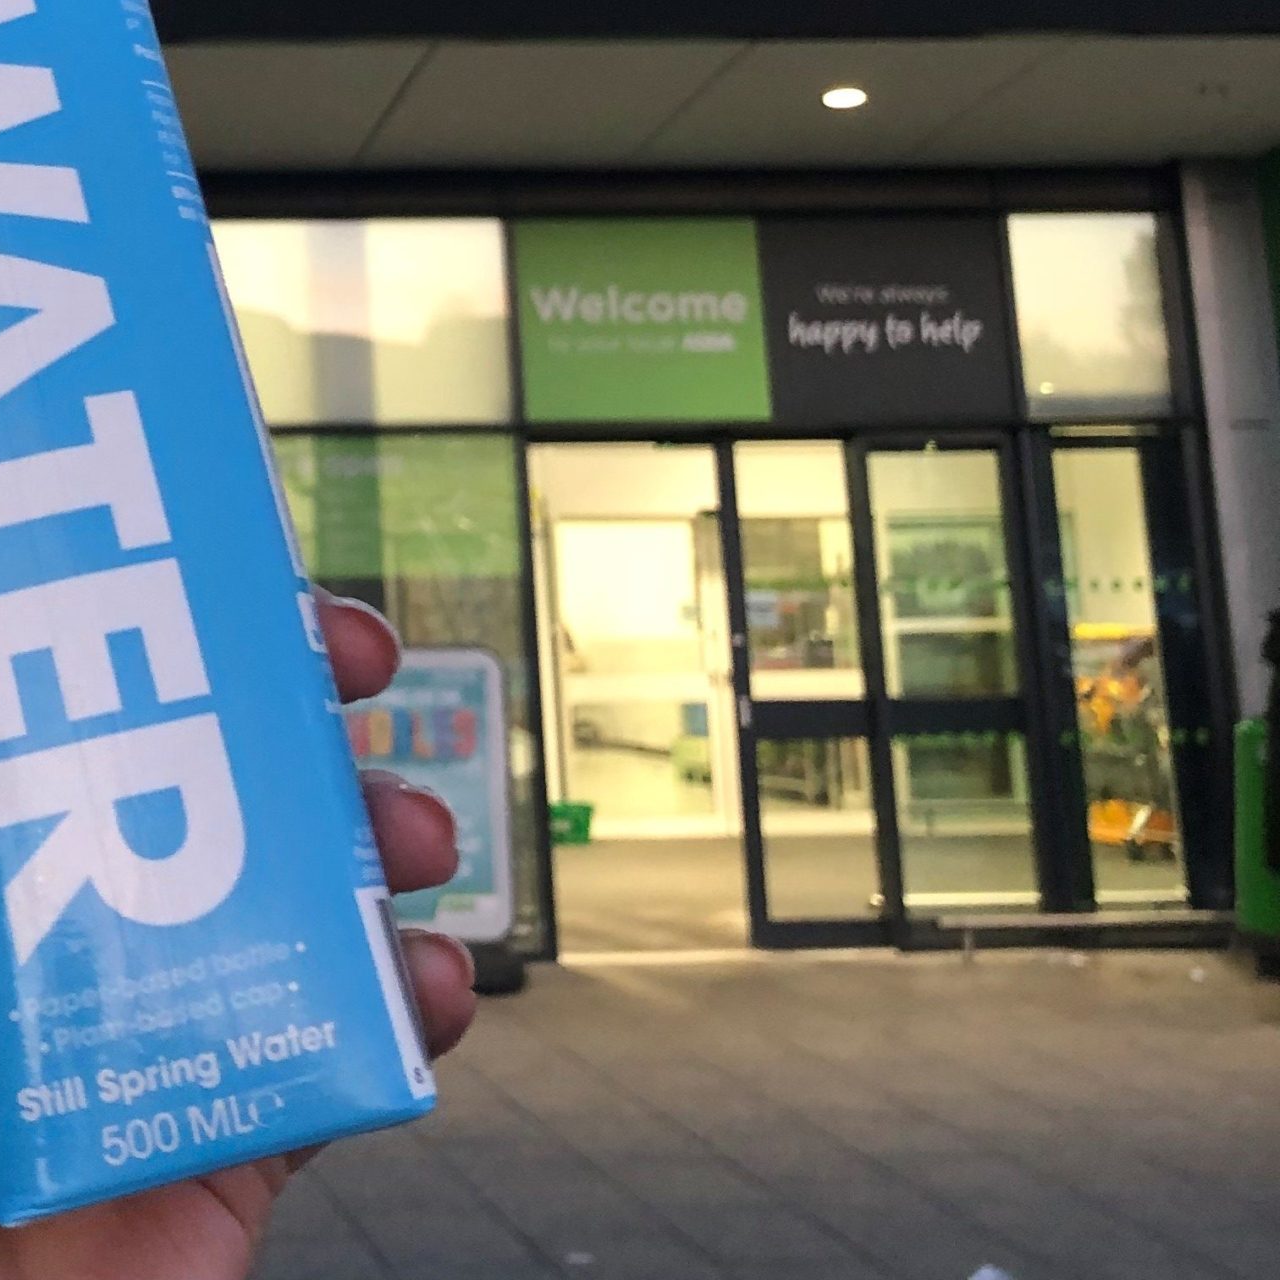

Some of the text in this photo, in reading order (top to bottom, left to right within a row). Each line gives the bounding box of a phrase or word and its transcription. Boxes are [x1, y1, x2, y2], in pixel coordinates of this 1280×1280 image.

[530, 284, 747, 324] Welcome
[789, 310, 983, 354] happy to help
[17, 1021, 336, 1121] Still Spring Water
[101, 1095, 254, 1166] 500 ML
